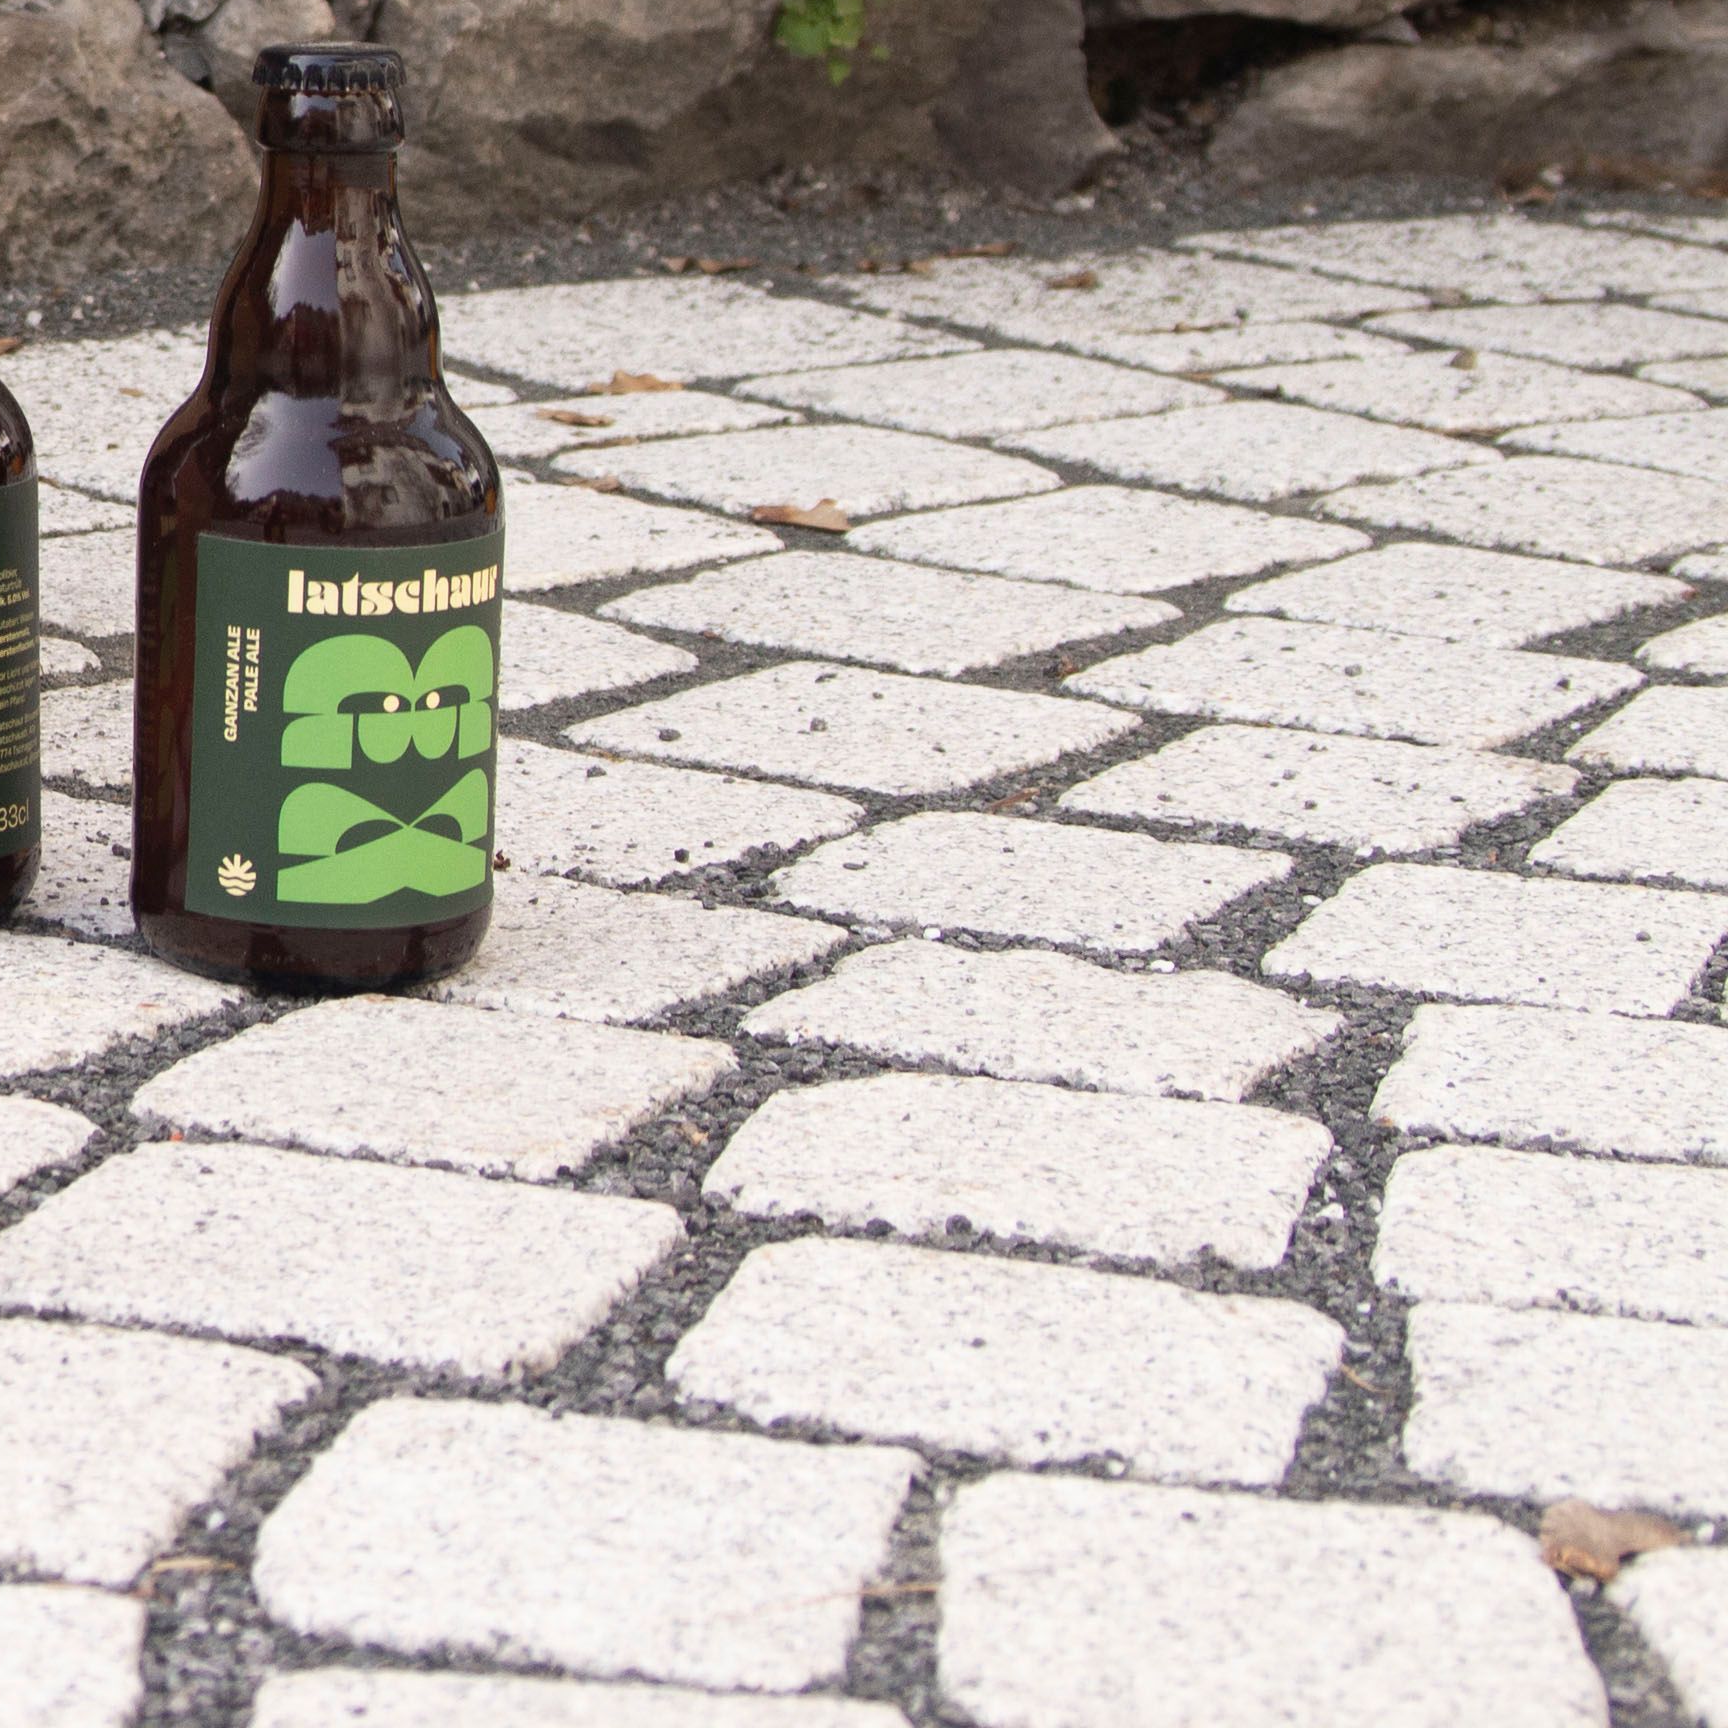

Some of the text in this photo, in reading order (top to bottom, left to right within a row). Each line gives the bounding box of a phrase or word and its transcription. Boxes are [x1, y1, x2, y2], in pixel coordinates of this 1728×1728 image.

[287, 565, 498, 616] latschaur
[224, 624, 241, 742] GANZAN ALE
[244, 627, 260, 712] PALE ALE
